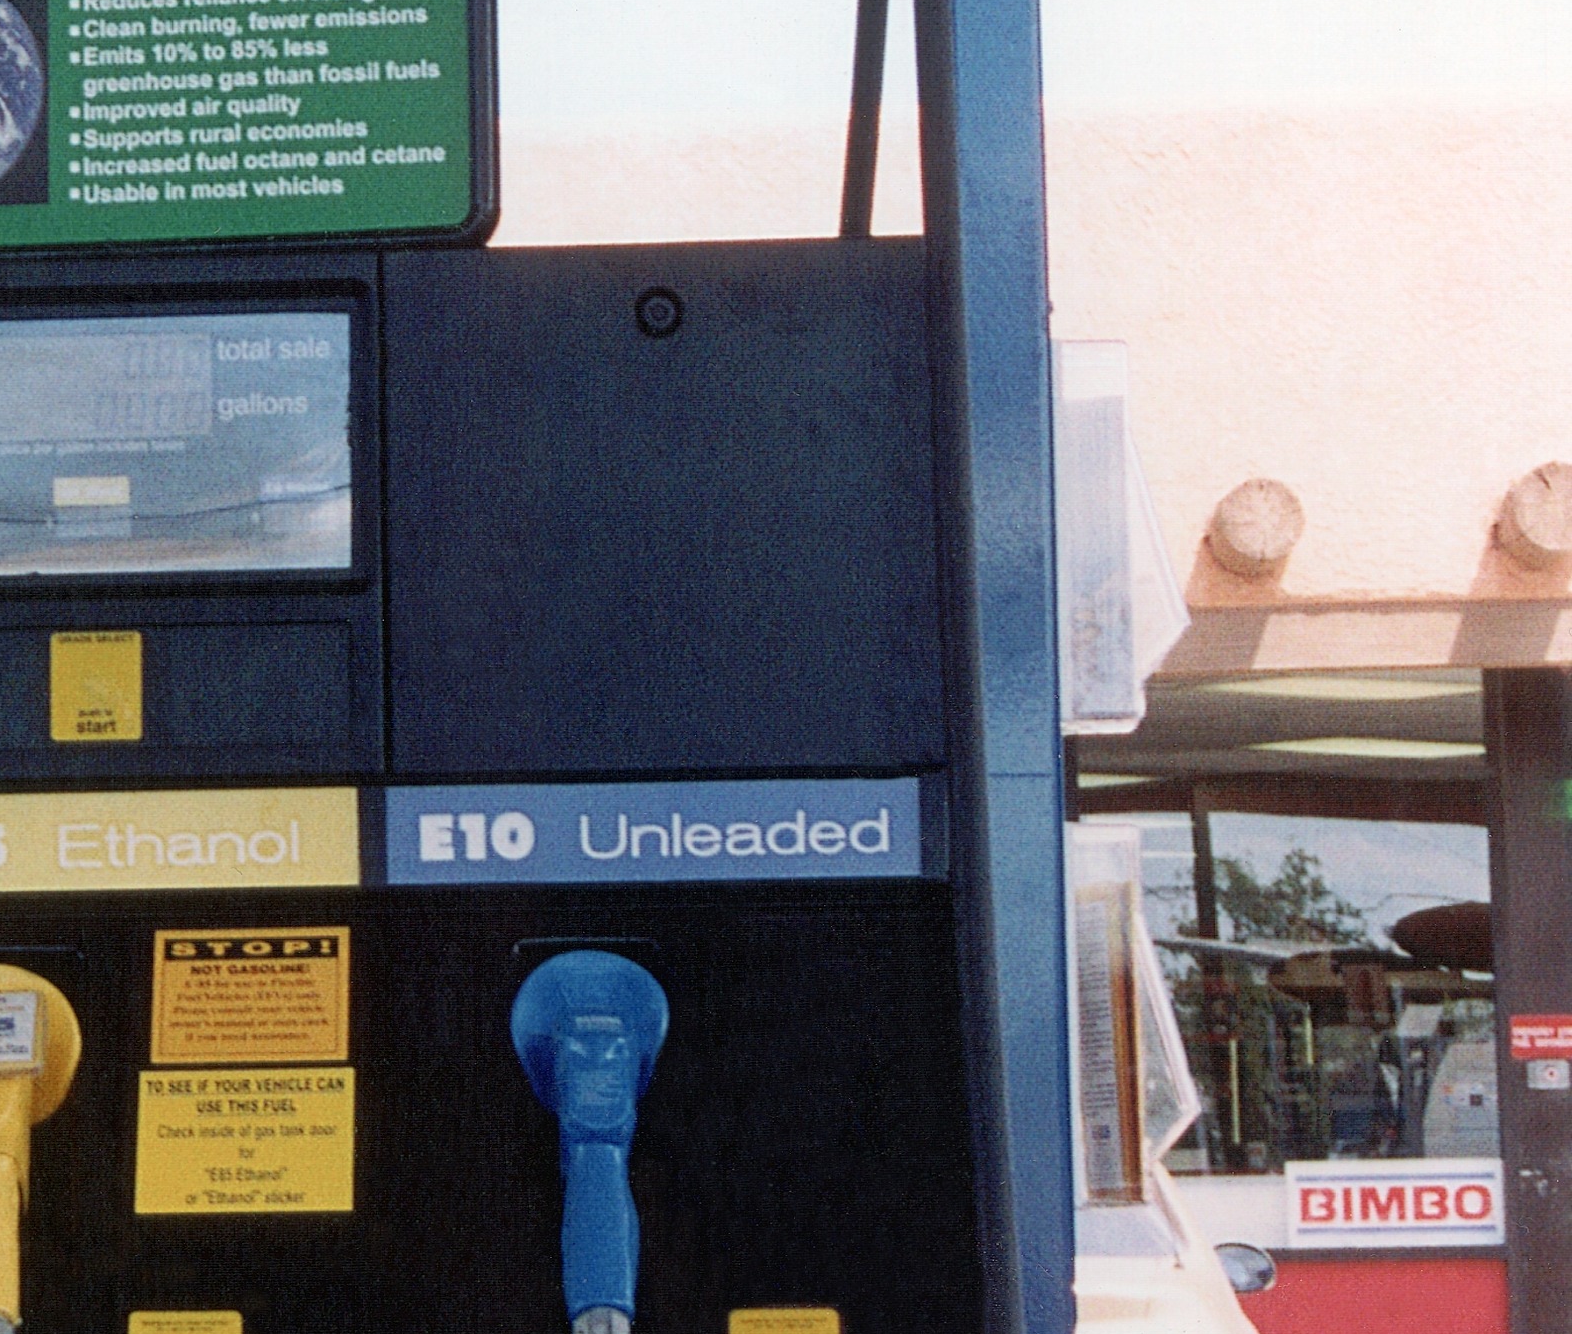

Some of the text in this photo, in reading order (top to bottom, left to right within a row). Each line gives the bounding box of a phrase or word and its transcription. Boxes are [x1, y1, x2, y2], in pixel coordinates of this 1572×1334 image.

[82, 6, 428, 38] Clean burning, fewer emissions
[82, 38, 329, 66] Emits 10% to 85% less
[83, 58, 441, 98] greenhouse gas than fossil fuels
[82, 94, 301, 124] Improved air quality
[83, 118, 368, 151] Supports rural economies
[82, 145, 446, 176] Increased fuel octane and cetane
[82, 175, 344, 204] Usable in most vehicles
[217, 338, 273, 361] total
[279, 337, 329, 359] sale
[217, 393, 309, 420] gallons
[58, 820, 300, 868] Ethanol
[419, 808, 890, 861] E10 Unleaded
[171, 940, 332, 958] STOP!
[146, 1076, 345, 1093] TO SEE IF YOUR VEHICLE CAN
[197, 1099, 297, 1113] USE THIS FUEL
[157, 1124, 194, 1139] Check
[199, 1123, 235, 1138] inside
[255, 1126, 275, 1140] gas
[1300, 1184, 1492, 1222] BIMBO
